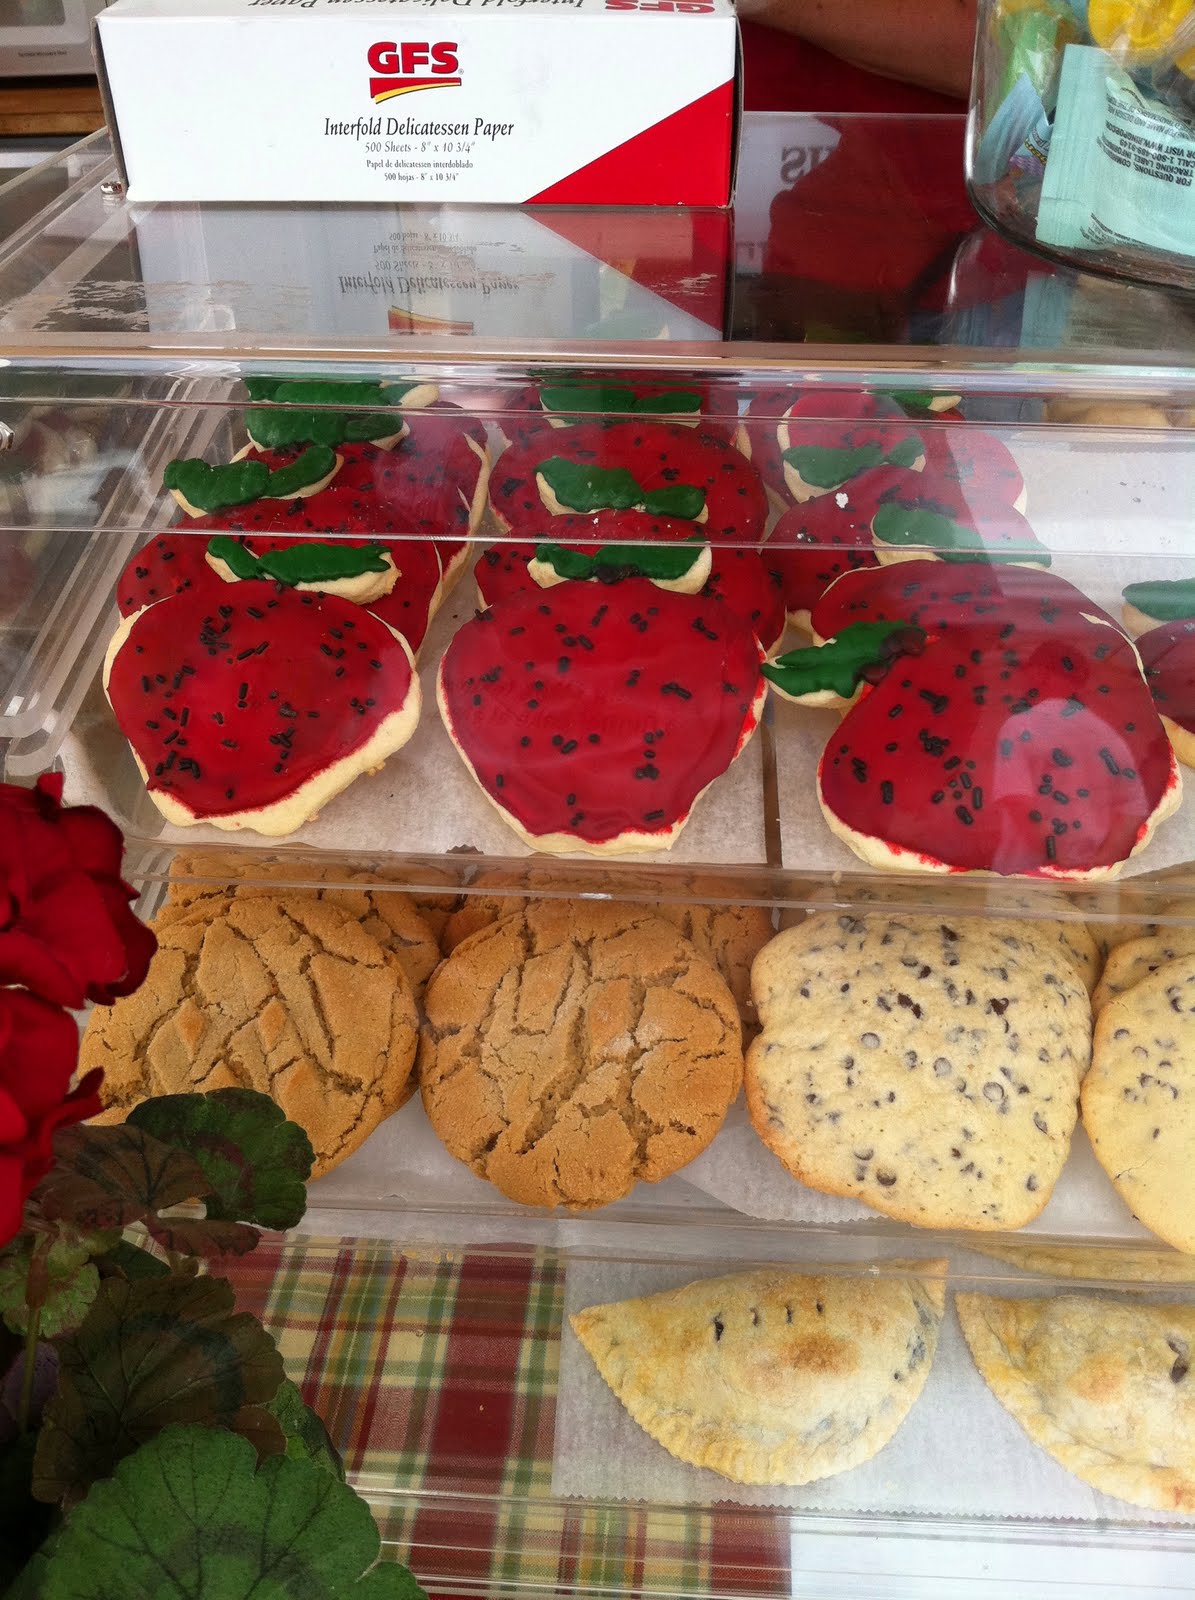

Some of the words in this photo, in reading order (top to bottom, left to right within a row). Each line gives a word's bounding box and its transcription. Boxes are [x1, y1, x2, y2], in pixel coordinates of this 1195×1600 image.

[367, 41, 459, 74] GFS
[324, 117, 382, 141] Interfold
[386, 117, 469, 136] Delicatessen
[474, 118, 515, 141] Paper
[365, 142, 382, 153] 500
[384, 141, 412, 152] Sheets
[443, 142, 453, 152] 10
[1165, 145, 1185, 157] VISIT
[366, 159, 384, 170] Papel
[385, 159, 392, 168] de
[394, 159, 432, 168] delicatessen
[433, 159, 474, 168] interdoblado
[1133, 153, 1154, 167] LABEL
[1156, 164, 1194, 178] TRACKING
[384, 172, 397, 181] 500
[398, 172, 414, 183] hojas
[435, 173, 444, 181] 10
[1176, 178, 1192, 187] FOR
